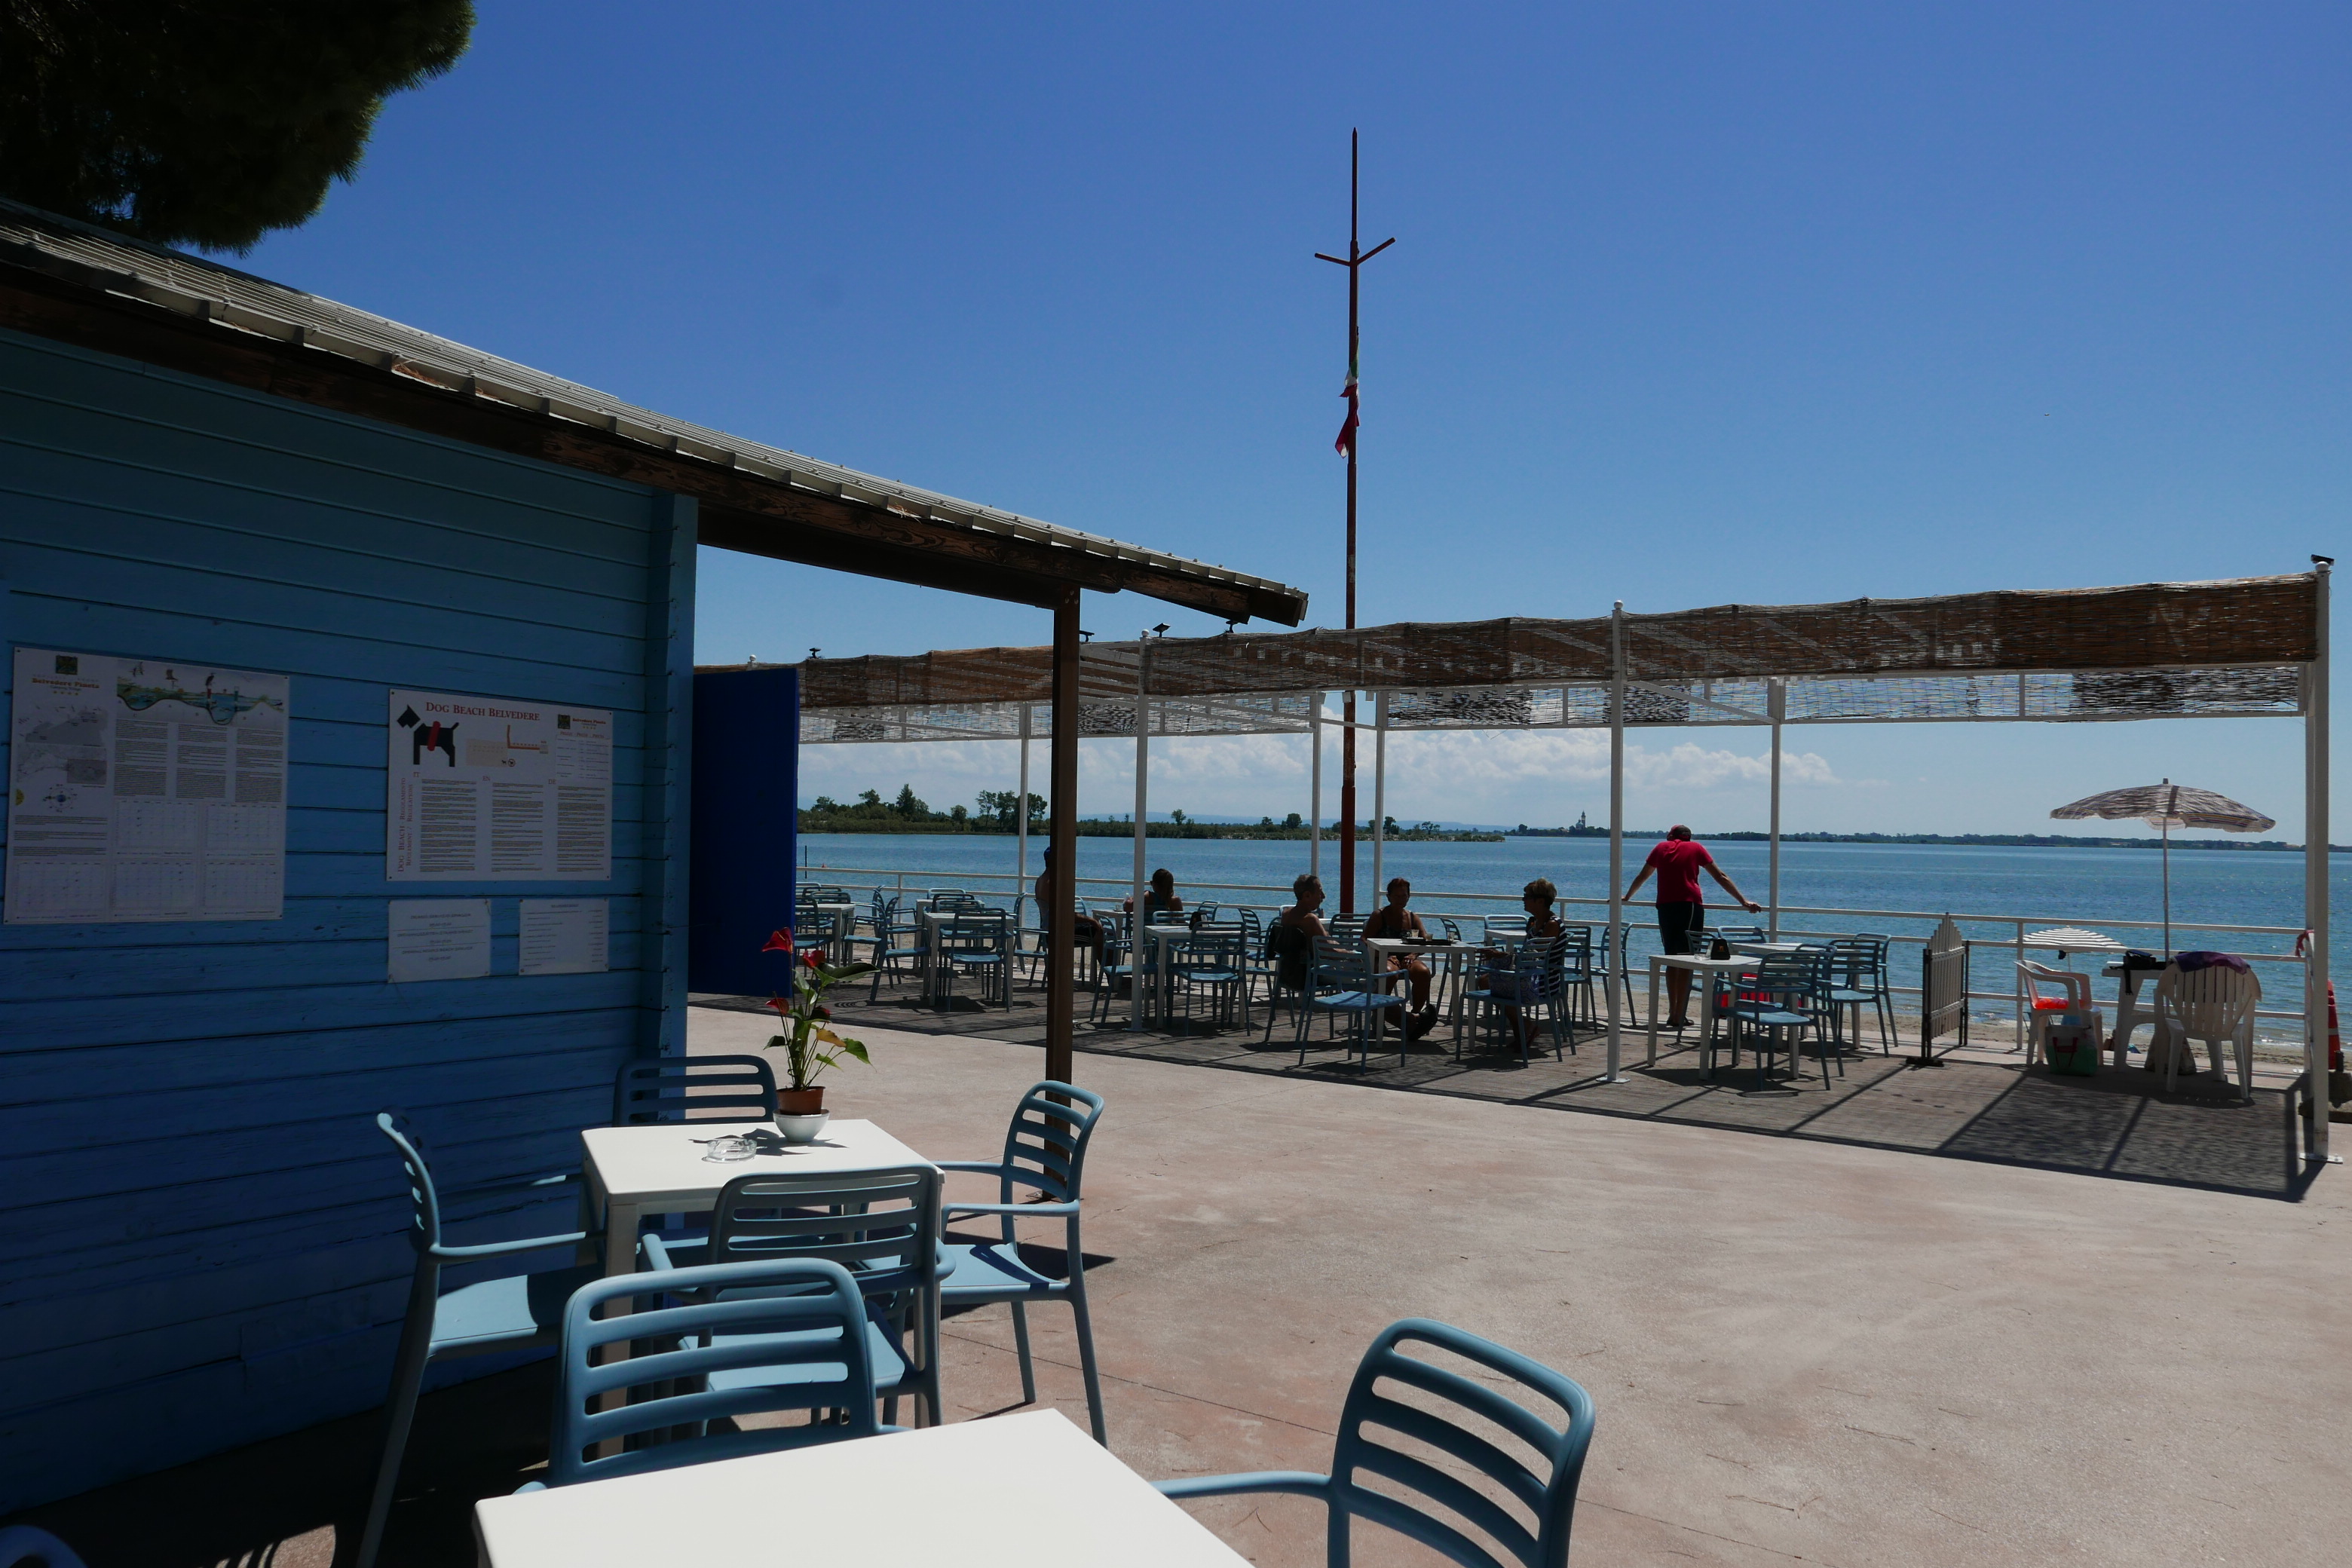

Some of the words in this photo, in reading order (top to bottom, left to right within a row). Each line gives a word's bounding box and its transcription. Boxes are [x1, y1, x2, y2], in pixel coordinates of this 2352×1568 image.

[426, 702, 449, 713] DOG
[453, 704, 485, 716] BEACH
[488, 707, 541, 721] BELVEDERE
